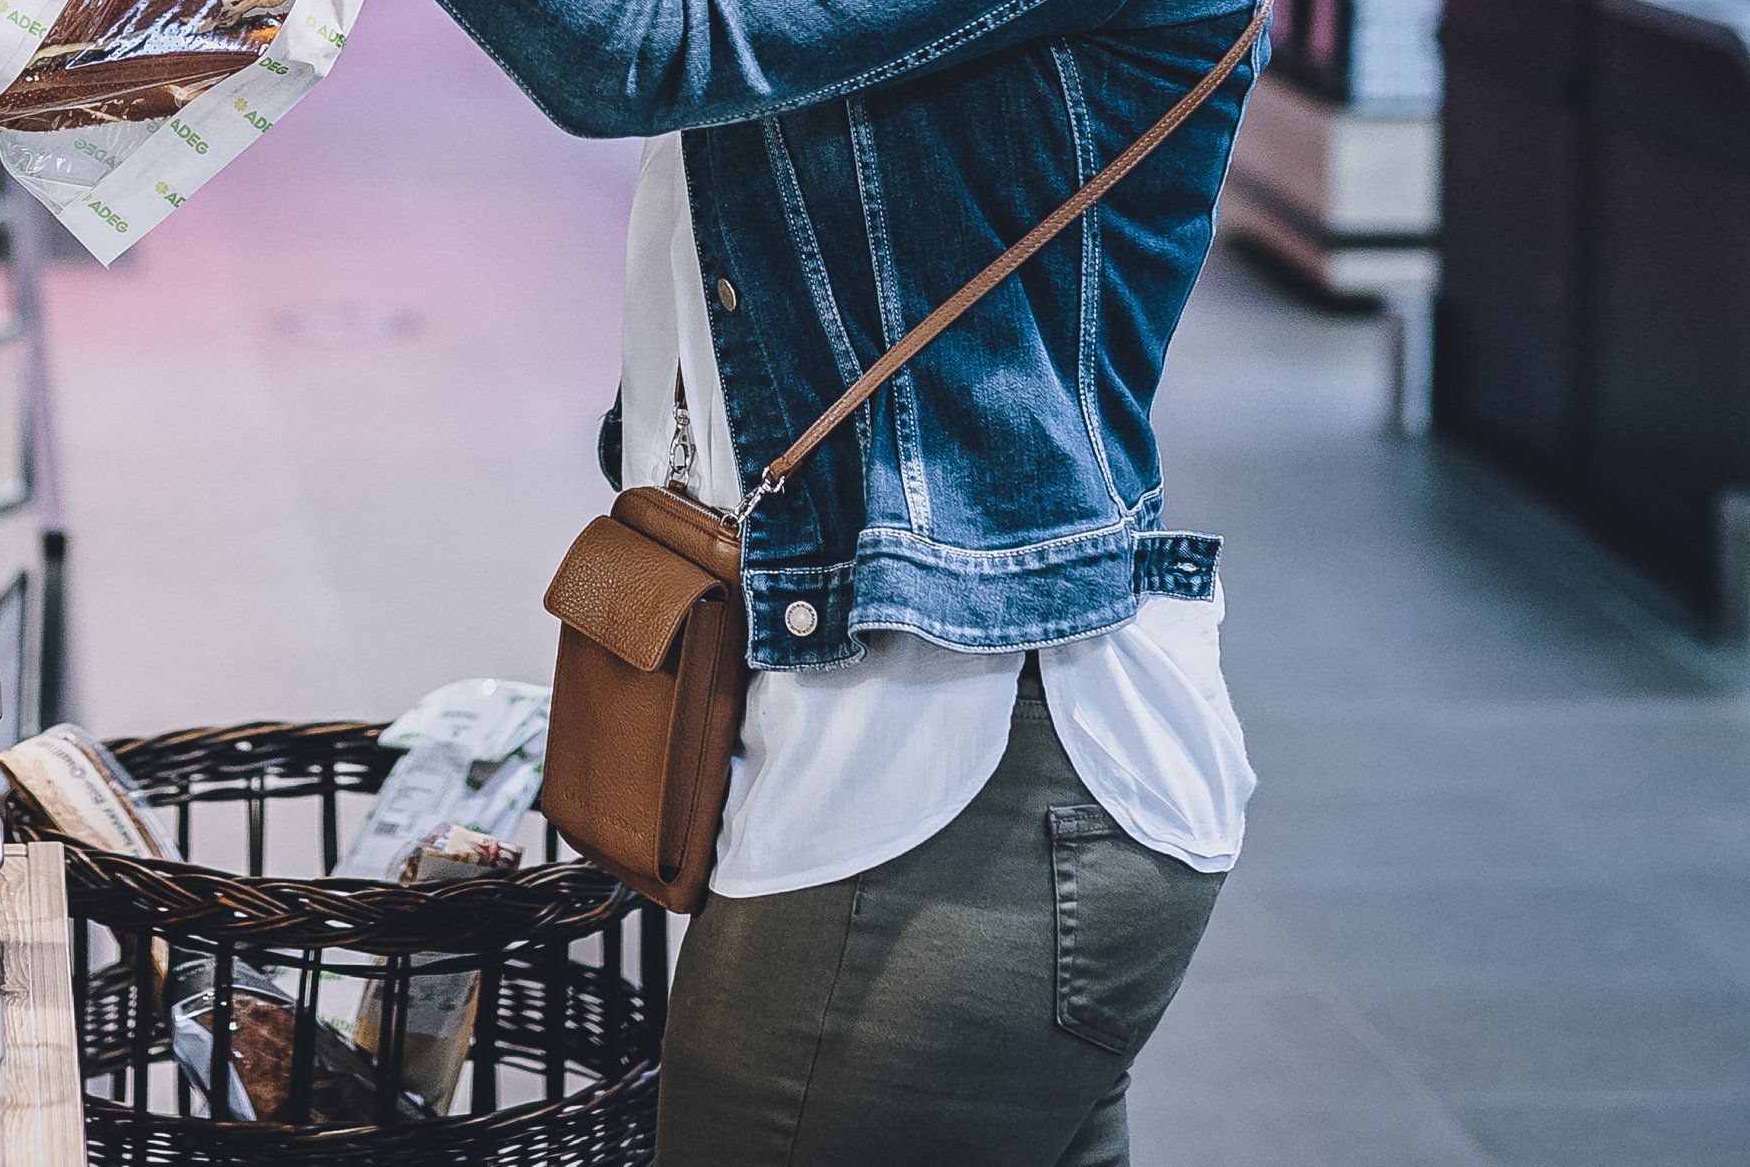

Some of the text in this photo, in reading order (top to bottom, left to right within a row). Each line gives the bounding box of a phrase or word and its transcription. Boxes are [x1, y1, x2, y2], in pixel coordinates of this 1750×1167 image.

[259, 56, 289, 75] DEG
[170, 118, 209, 155] ADEG
[88, 201, 129, 234] ADEG
